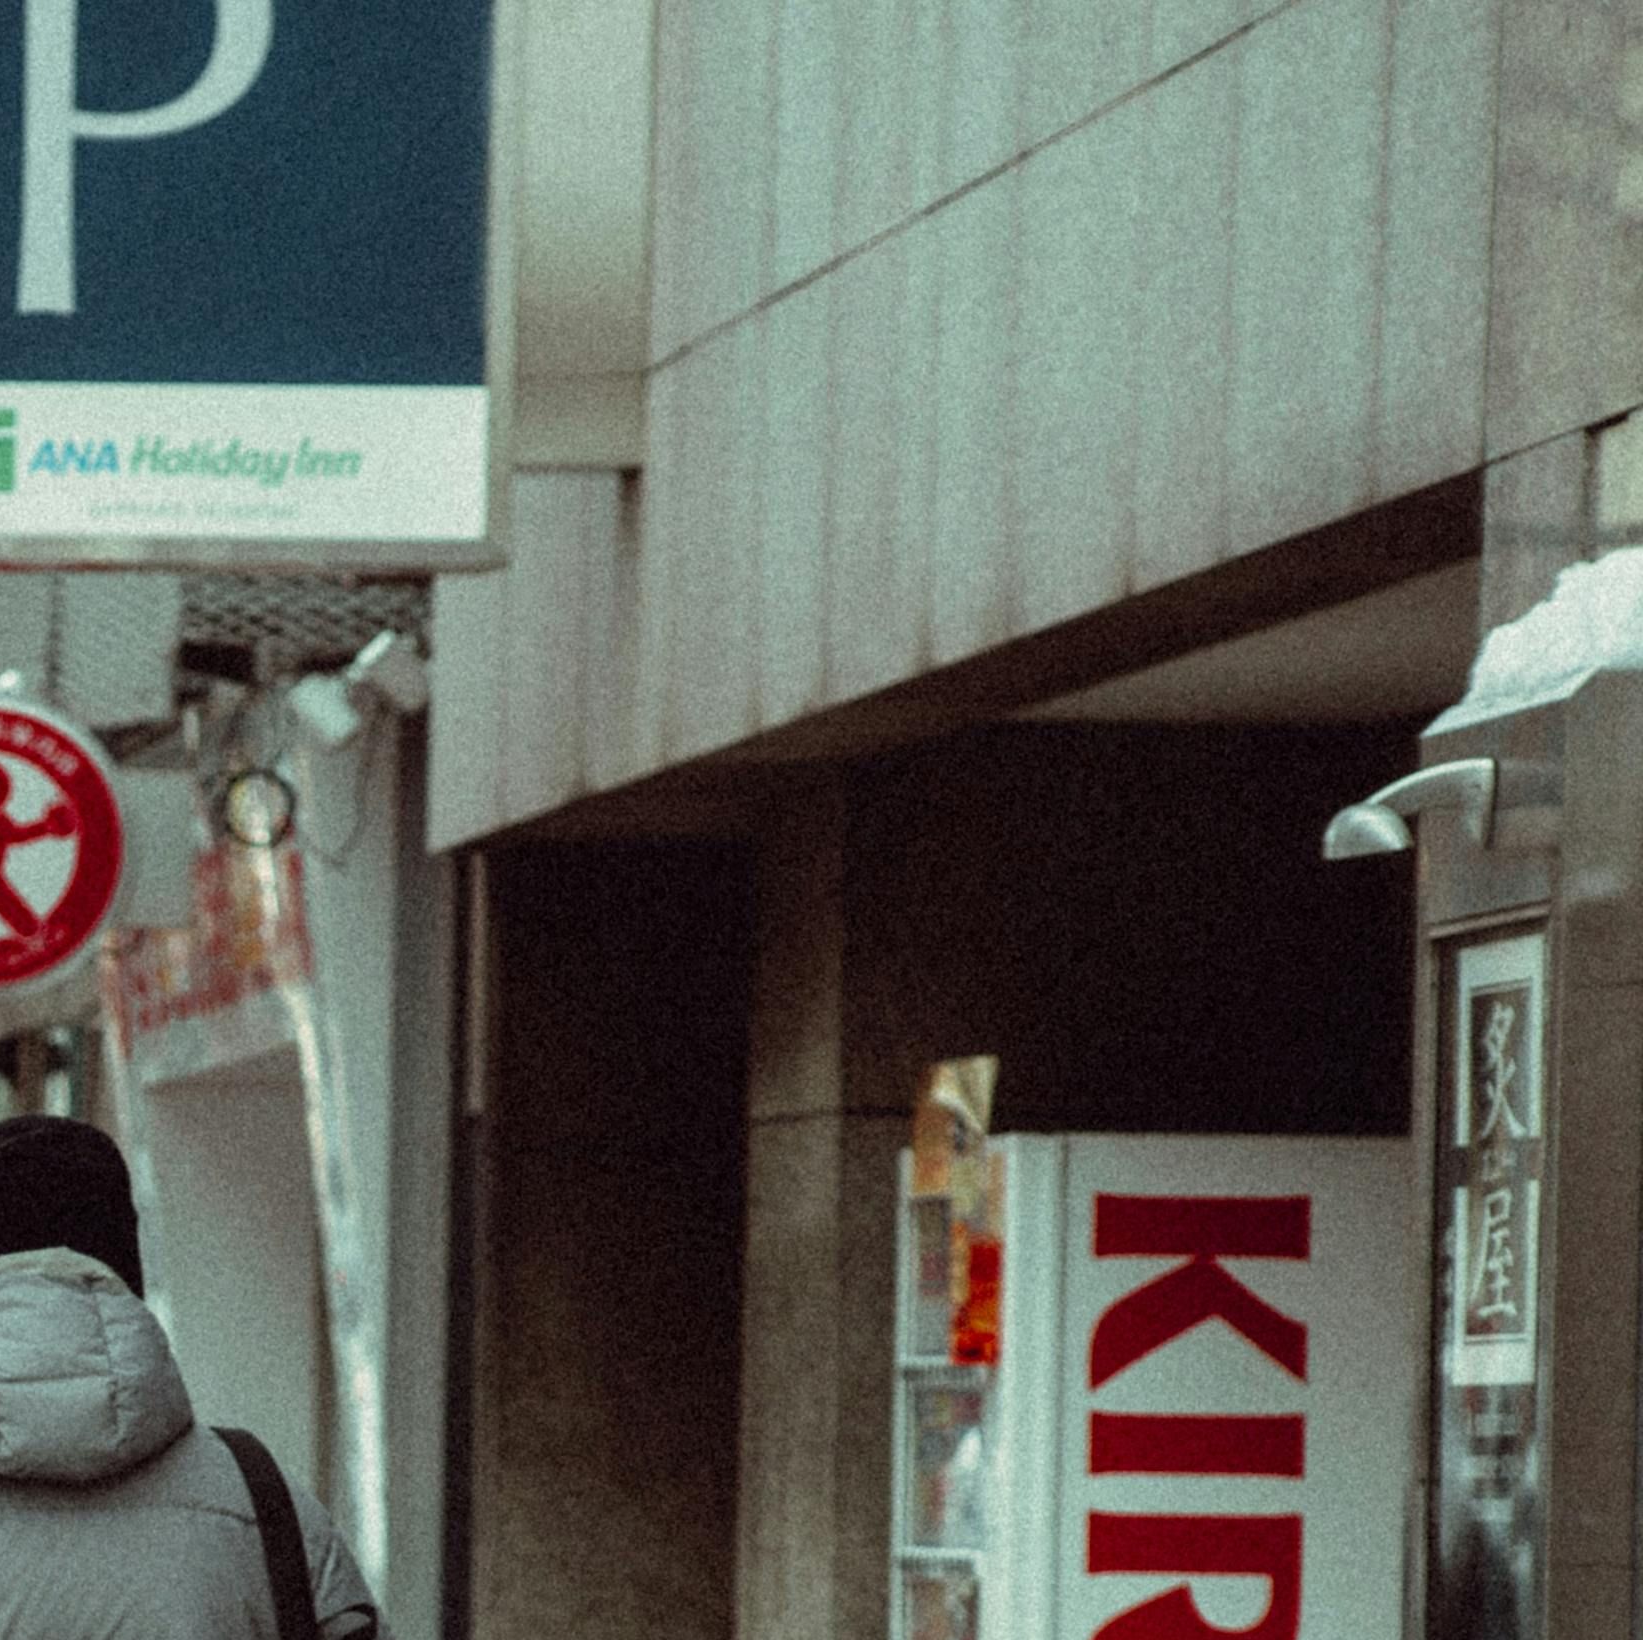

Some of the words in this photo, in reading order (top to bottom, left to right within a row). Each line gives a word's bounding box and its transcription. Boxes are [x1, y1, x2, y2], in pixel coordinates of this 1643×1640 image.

[16, 0, 275, 315] P
[28, 438, 121, 476] ANA
[129, 434, 291, 488] Holiday
[295, 436, 363, 477] Inn
